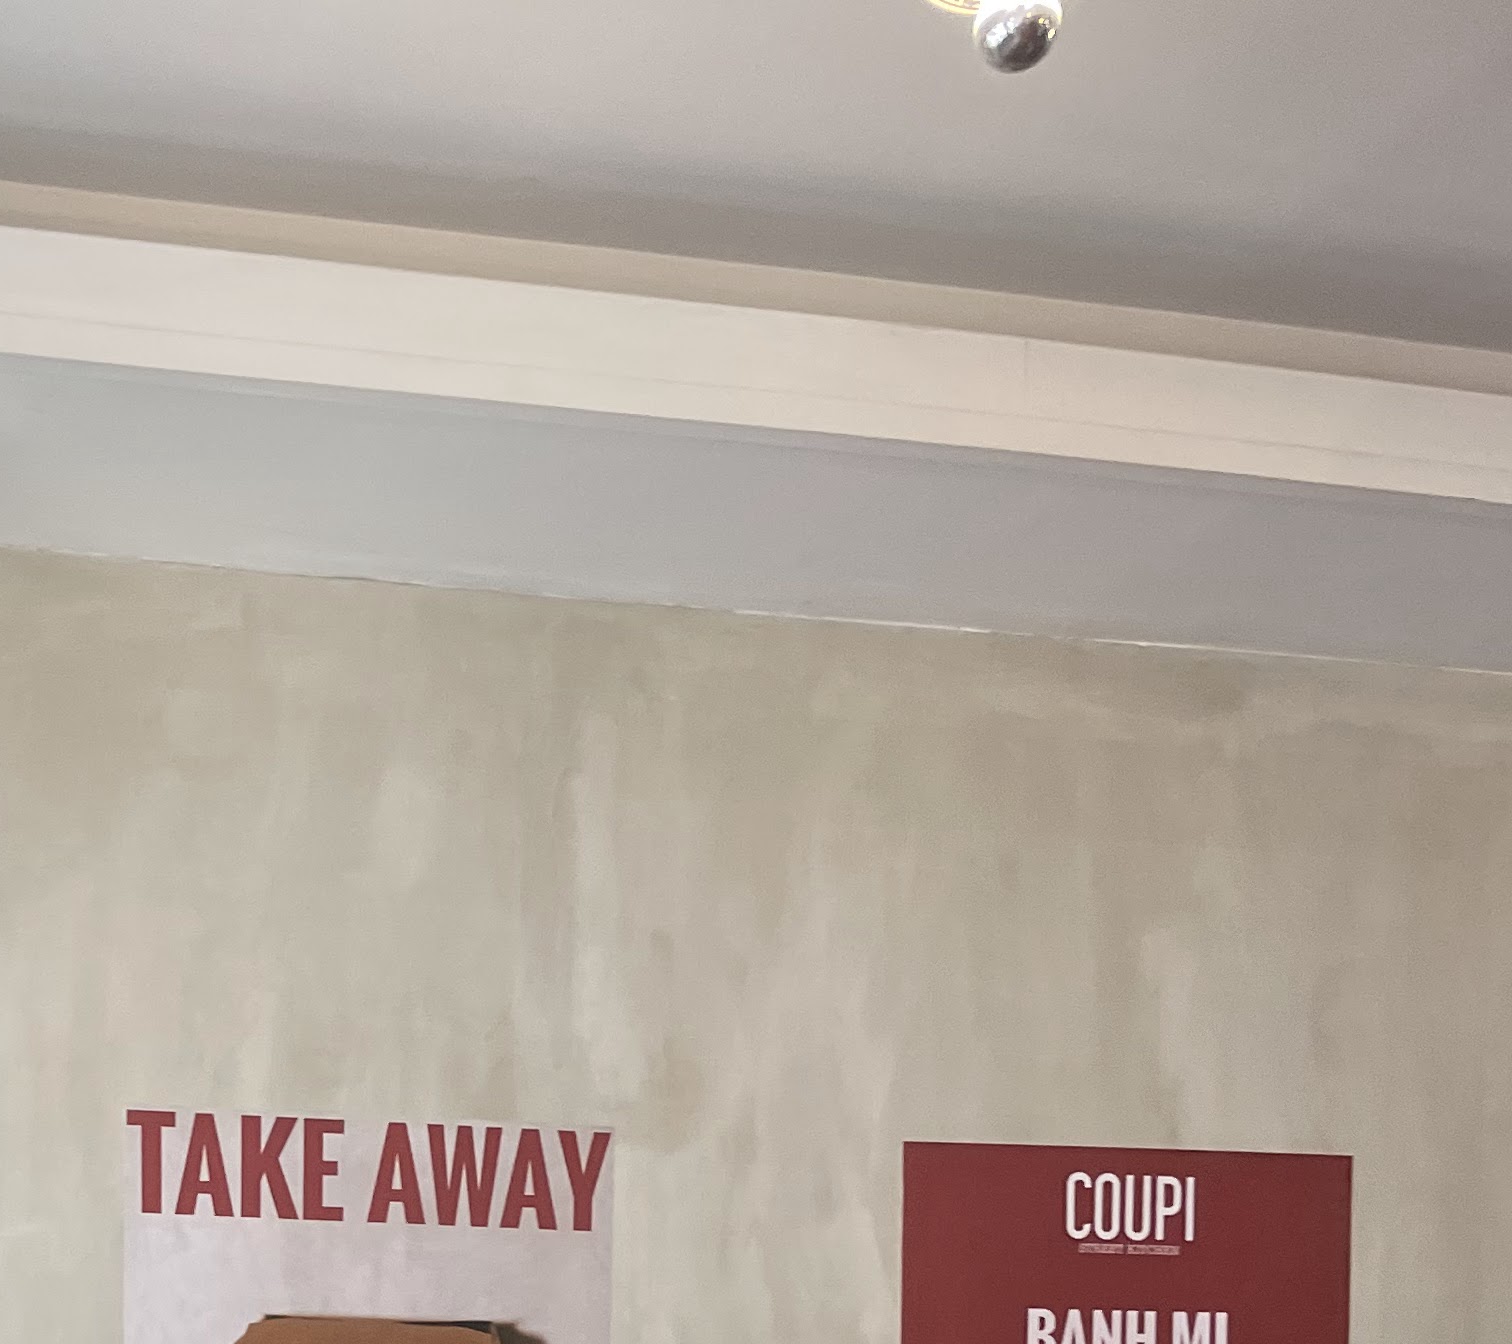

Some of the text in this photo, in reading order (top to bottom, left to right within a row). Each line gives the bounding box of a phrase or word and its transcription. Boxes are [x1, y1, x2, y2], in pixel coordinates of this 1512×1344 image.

[126, 1109, 613, 1232] TAKE AWAY
[1065, 1171, 1195, 1243] COUPI
